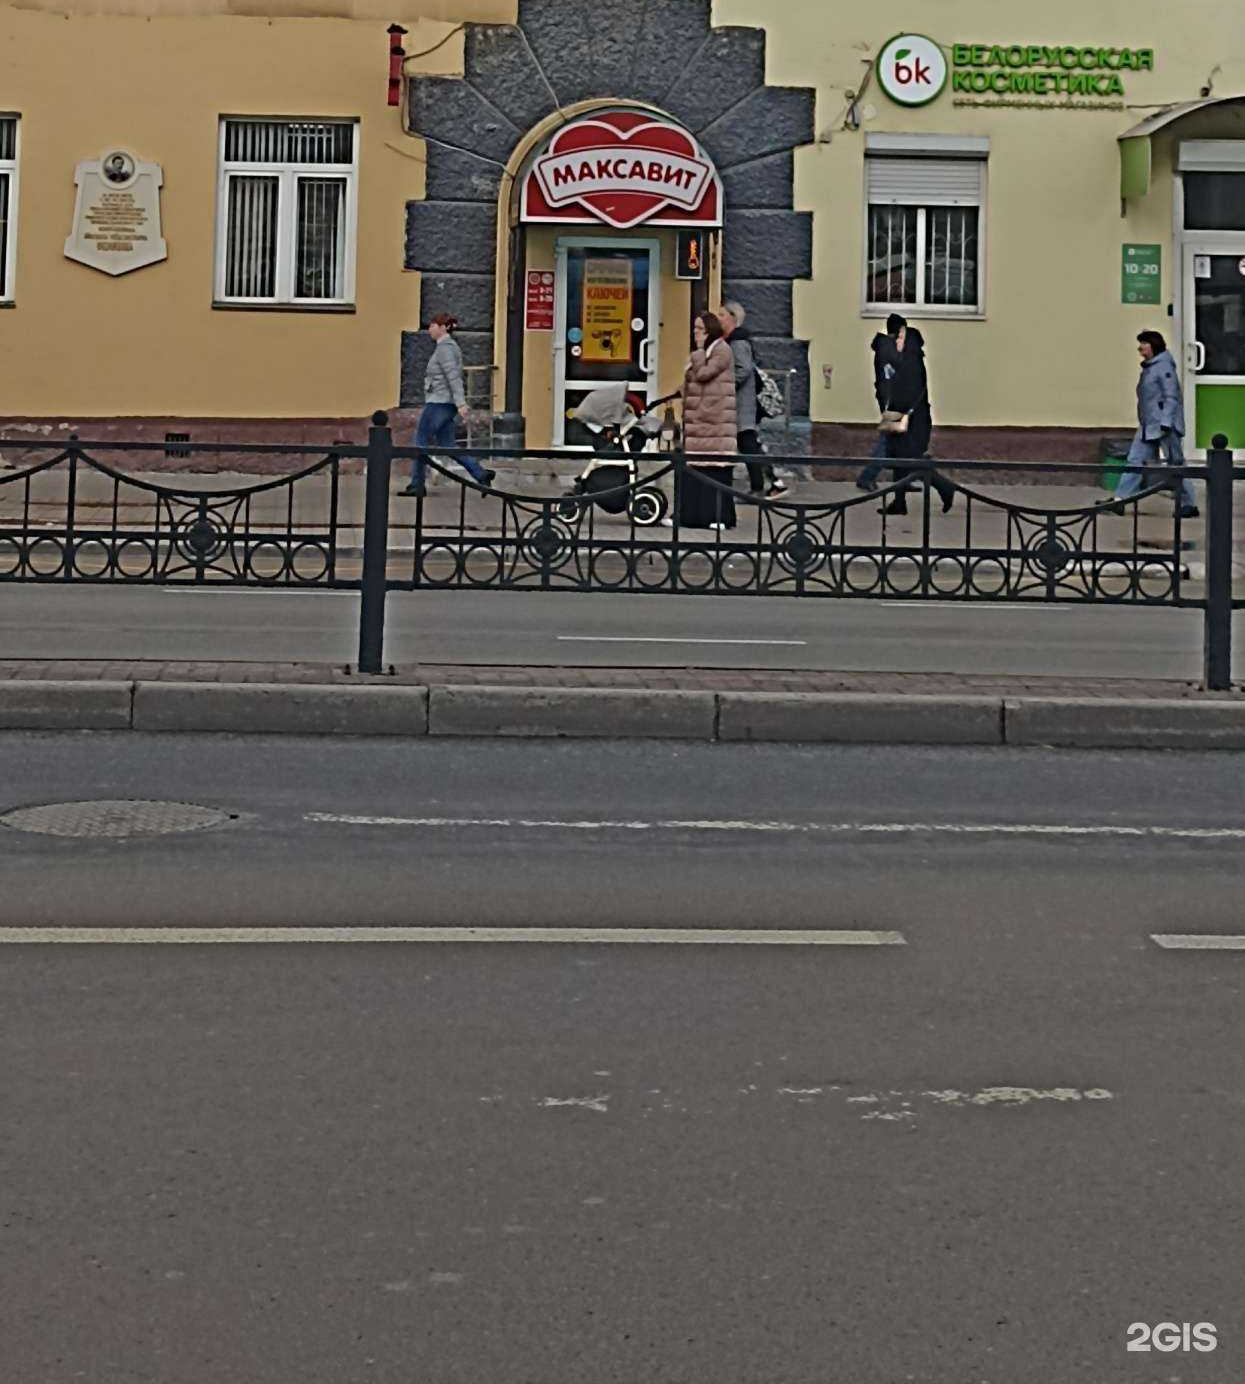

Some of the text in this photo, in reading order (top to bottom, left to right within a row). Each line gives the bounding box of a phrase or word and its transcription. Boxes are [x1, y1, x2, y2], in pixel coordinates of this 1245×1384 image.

[953, 44, 1153, 70] БЕЛОРУССКАЯ
[953, 70, 1124, 96] КОСМЕТИКА
[553, 159, 697, 189] МАКСАВИТ
